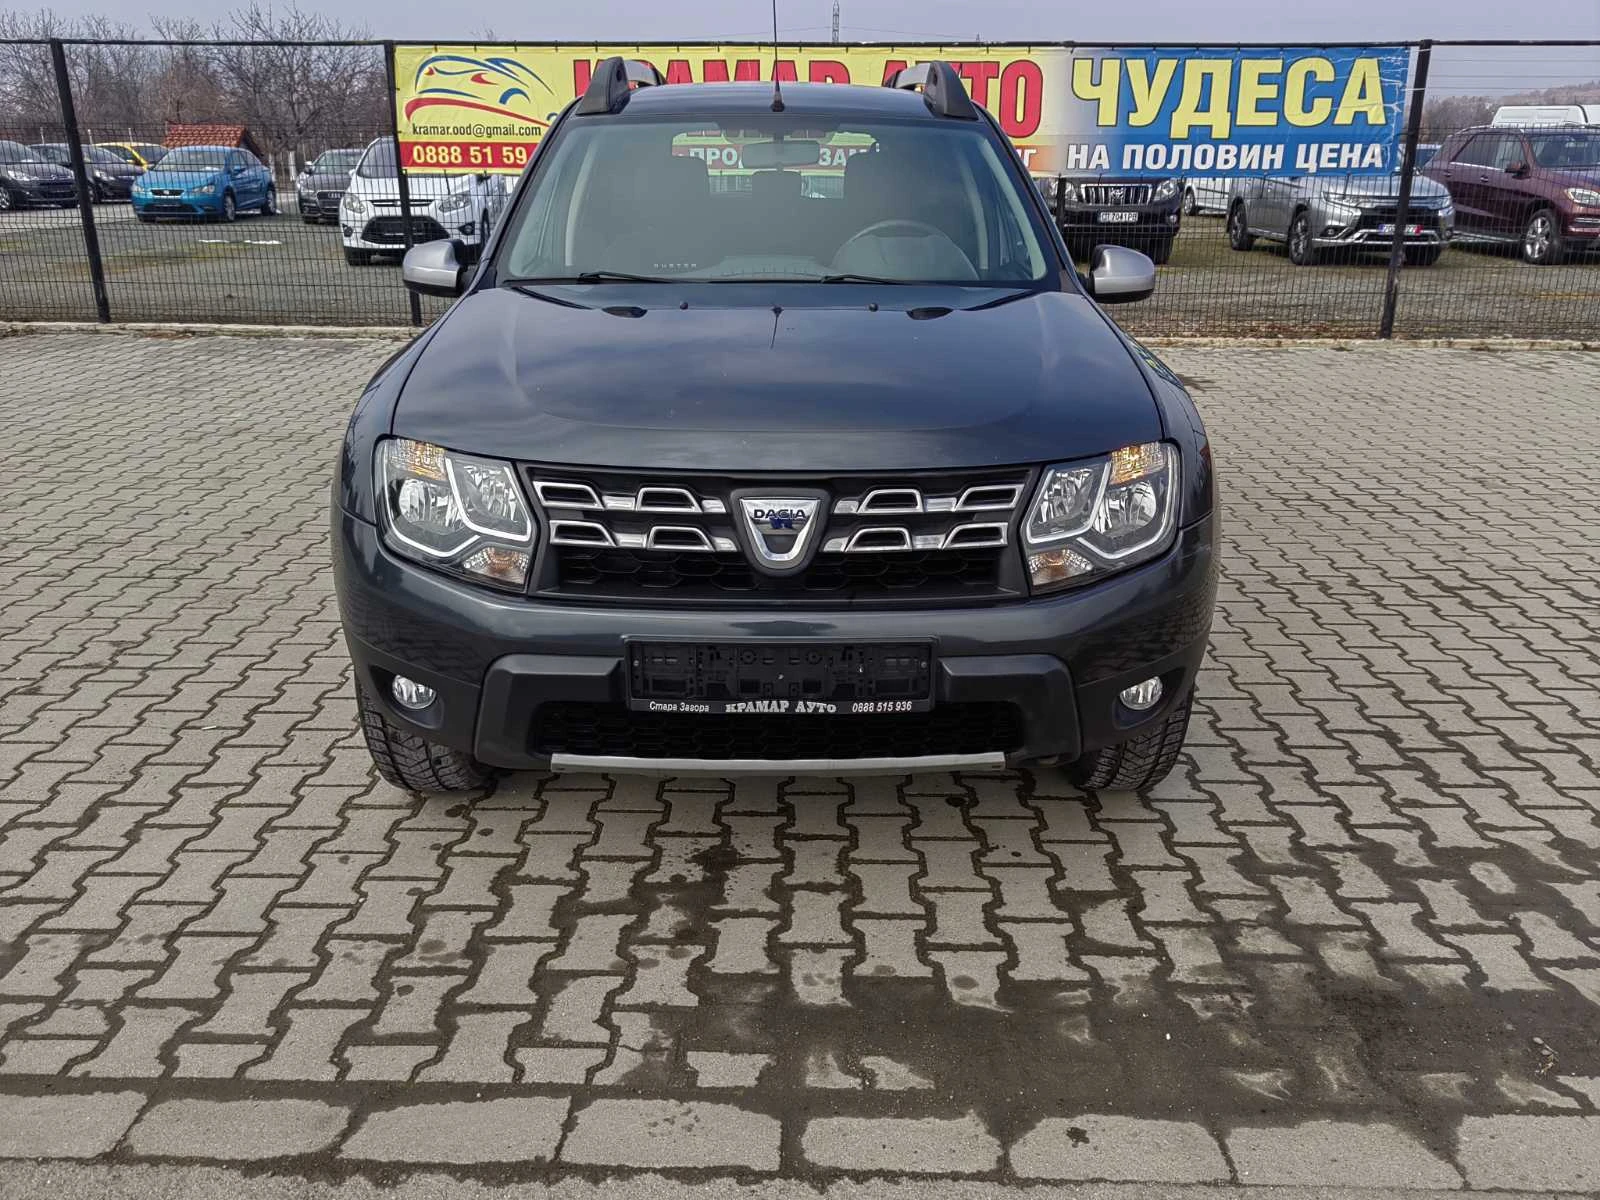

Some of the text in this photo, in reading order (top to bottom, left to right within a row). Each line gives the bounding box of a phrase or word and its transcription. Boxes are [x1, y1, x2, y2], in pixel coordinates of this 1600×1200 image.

[1071, 56, 1388, 140] ЧУДЕСА
[412, 123, 542, 138] kramar.ood@gmail.com
[412, 145, 527, 165] 0888 51 59
[1067, 142, 1384, 173] НА ПОЛОВИН ЦЕНА
[753, 508, 807, 519] DACIA
[649, 700, 710, 713] Стара Загора
[725, 700, 790, 713] КРАМАР
[852, 700, 913, 713] 0888 515 936
